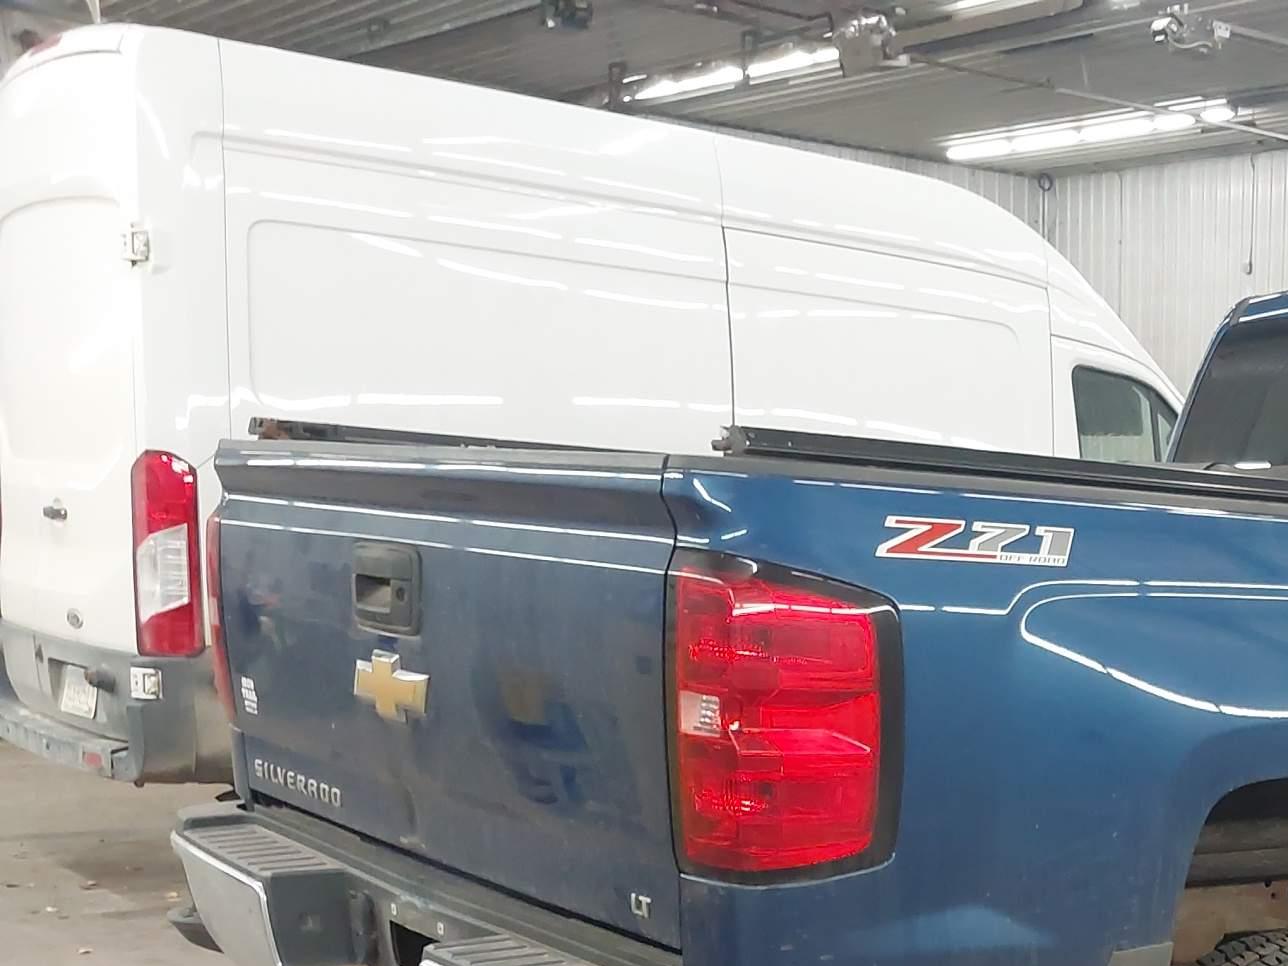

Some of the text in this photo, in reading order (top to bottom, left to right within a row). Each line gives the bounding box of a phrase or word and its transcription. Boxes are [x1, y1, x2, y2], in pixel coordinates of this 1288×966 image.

[875, 515, 1075, 563] Z71
[254, 758, 341, 808] SILVERADO
[630, 892, 652, 918] LT
